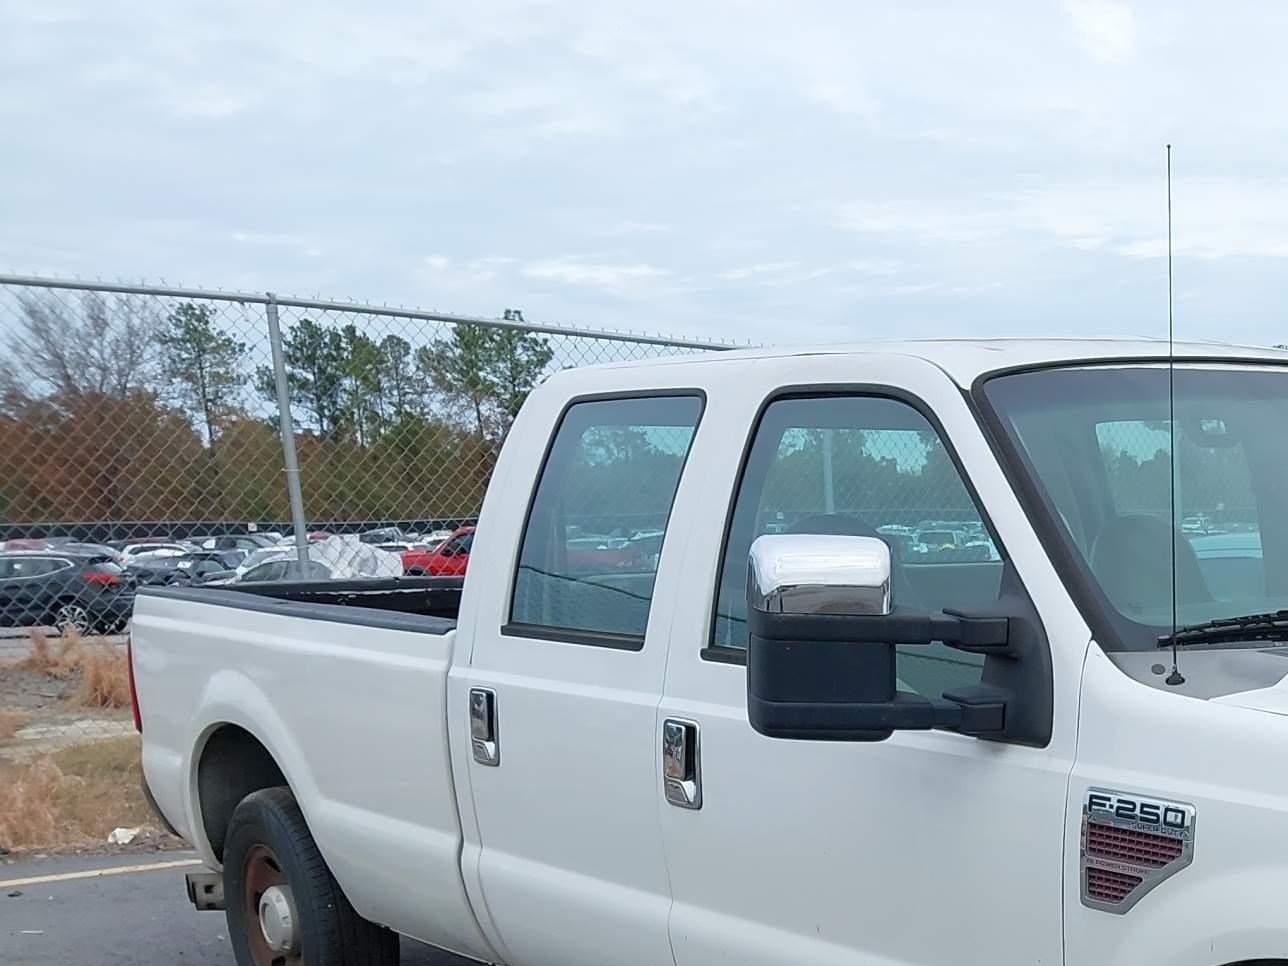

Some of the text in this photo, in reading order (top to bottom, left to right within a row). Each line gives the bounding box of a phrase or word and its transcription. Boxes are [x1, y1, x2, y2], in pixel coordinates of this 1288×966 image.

[1088, 794, 1186, 830] F-250
[1131, 822, 1185, 840] SUPER DUTY
